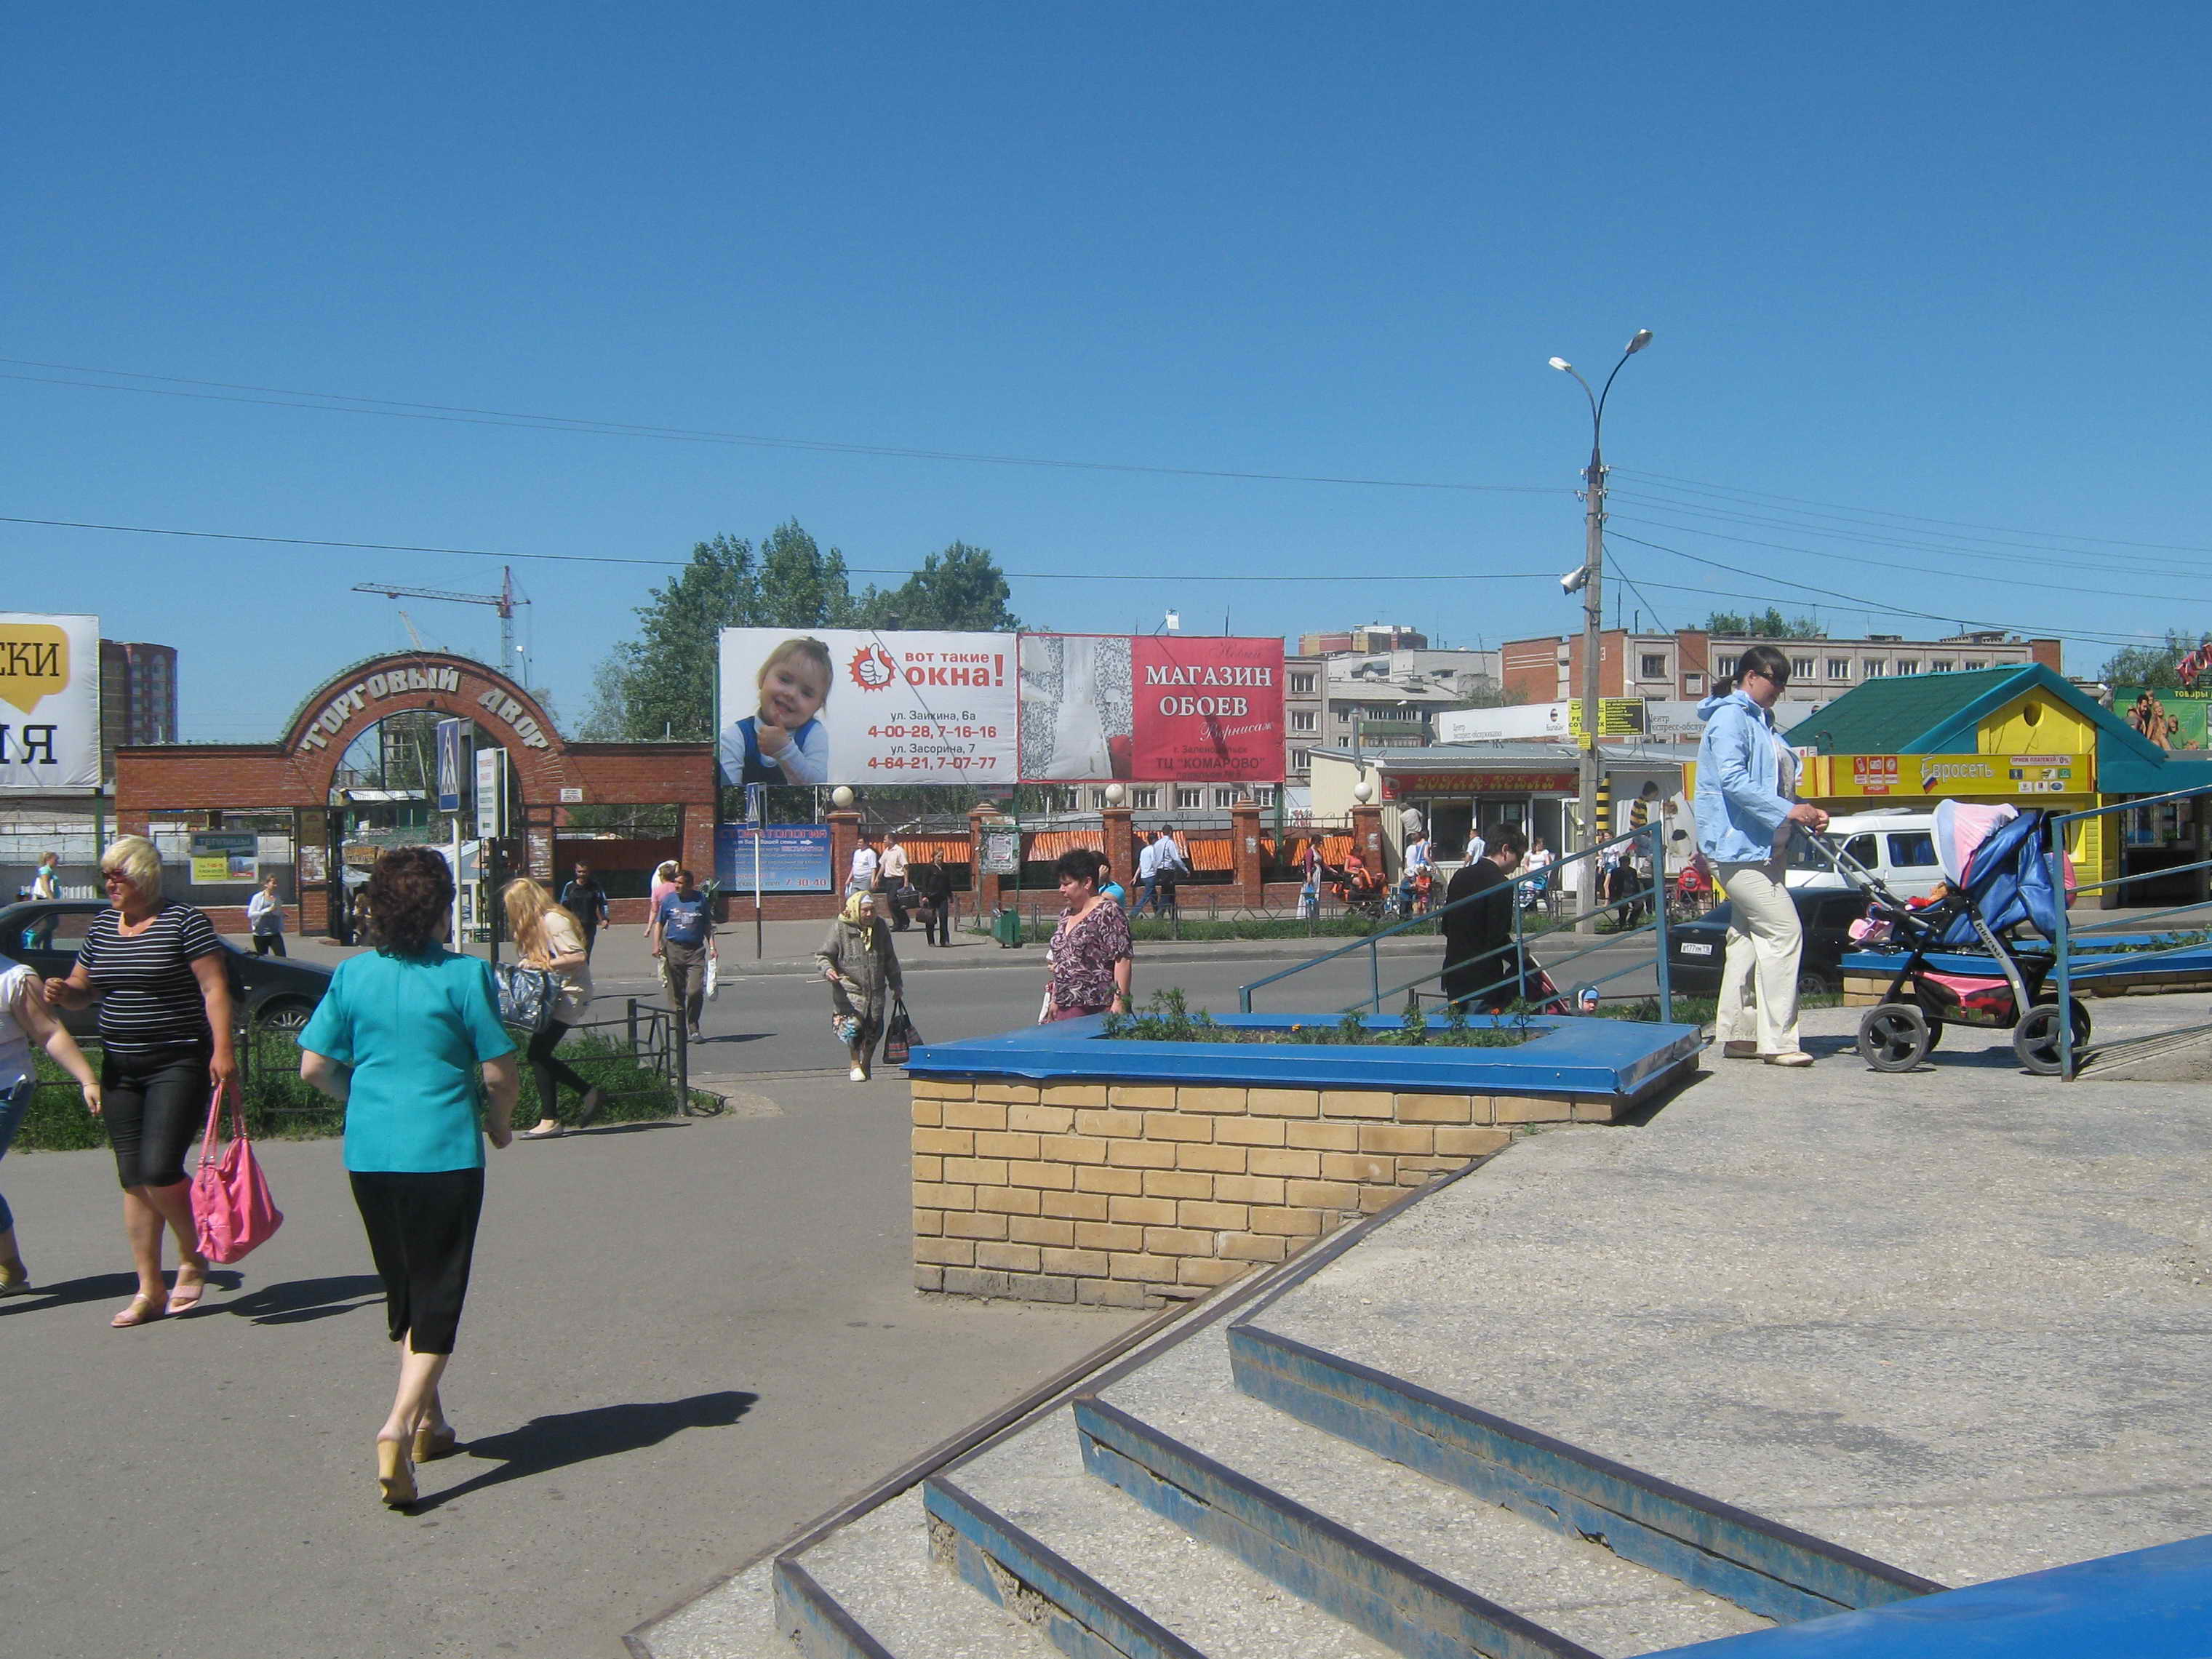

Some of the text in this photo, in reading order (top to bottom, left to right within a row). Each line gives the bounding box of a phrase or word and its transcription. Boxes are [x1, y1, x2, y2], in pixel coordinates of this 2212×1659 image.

[905, 652, 989, 663] вот такие
[906, 654, 1004, 687] окна!
[1144, 665, 1273, 687] МАГАЗИН
[300, 667, 548, 749] ТОРГОВЫЙ ДВОР
[1159, 696, 1249, 716] ОБОЕВ
[891, 711, 976, 722] ул. Заикина, 6а
[891, 743, 975, 756] ул. Засорина, 7
[1157, 758, 1174, 770] ТЦ
[1920, 756, 1995, 783] Евросеть
